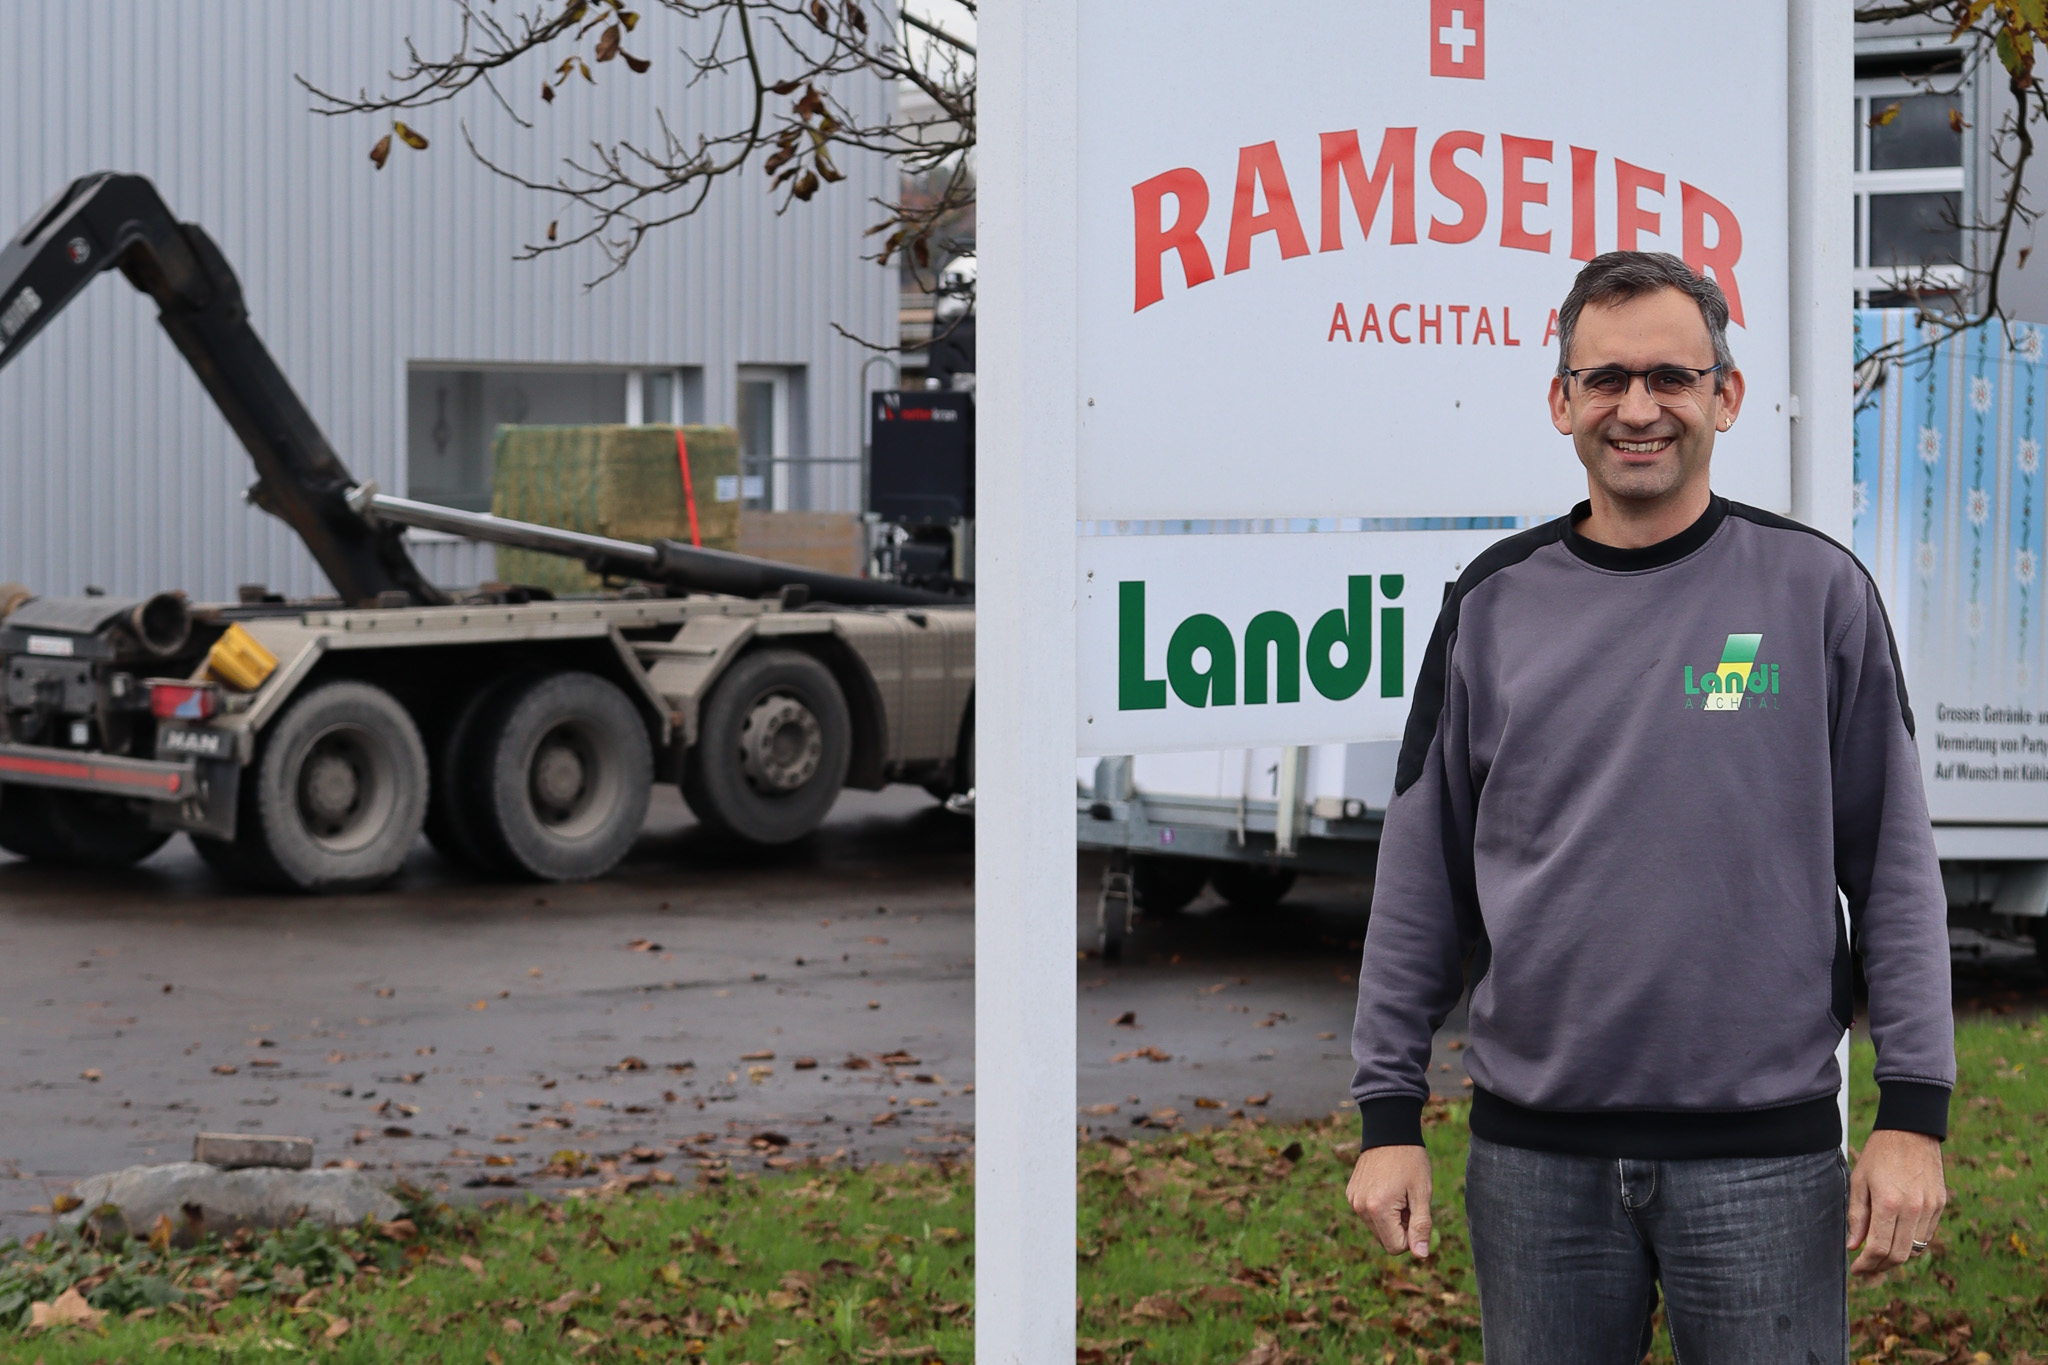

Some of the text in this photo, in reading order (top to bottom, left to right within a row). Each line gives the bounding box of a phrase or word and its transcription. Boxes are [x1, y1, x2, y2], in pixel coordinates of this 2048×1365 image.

[1132, 127, 1746, 329] RAMSEIER
[1327, 302, 1560, 347] AACHTAL A
[1118, 573, 1404, 711] Landi
[1684, 663, 1780, 695] Landi
[1684, 697, 1780, 710] AACHTAL
[1937, 703, 1981, 722] Grosses
[2039, 710, 2048, 725] u
[166, 730, 220, 753] MAN
[1936, 732, 1997, 757] Vermietung
[2001, 738, 2018, 753] von
[1936, 761, 1954, 780] Auf
[1957, 762, 1999, 781] Wunsch
[2003, 764, 2019, 781] mit
